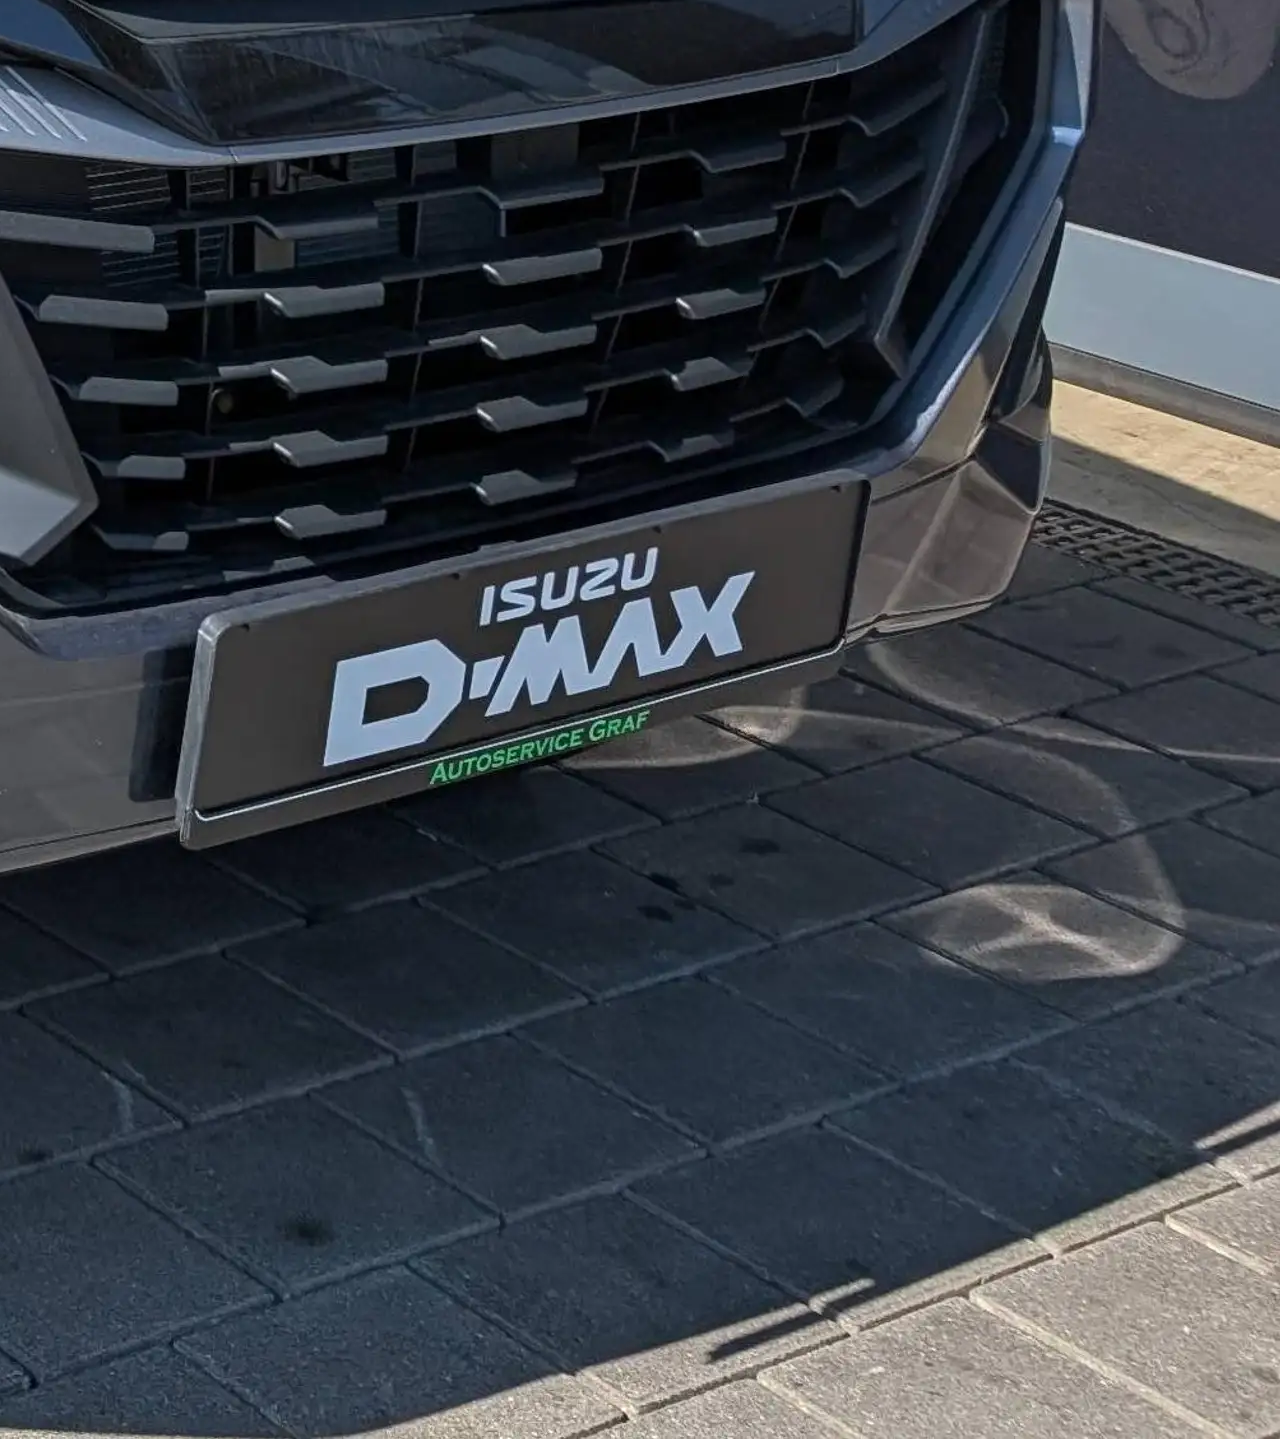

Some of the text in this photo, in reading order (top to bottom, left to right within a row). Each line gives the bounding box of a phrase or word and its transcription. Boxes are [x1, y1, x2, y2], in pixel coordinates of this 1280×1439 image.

[479, 546, 658, 627] ISUZU
[323, 570, 756, 767] D-MAX
[429, 709, 651, 786] AUTOSERVICE GRAF
